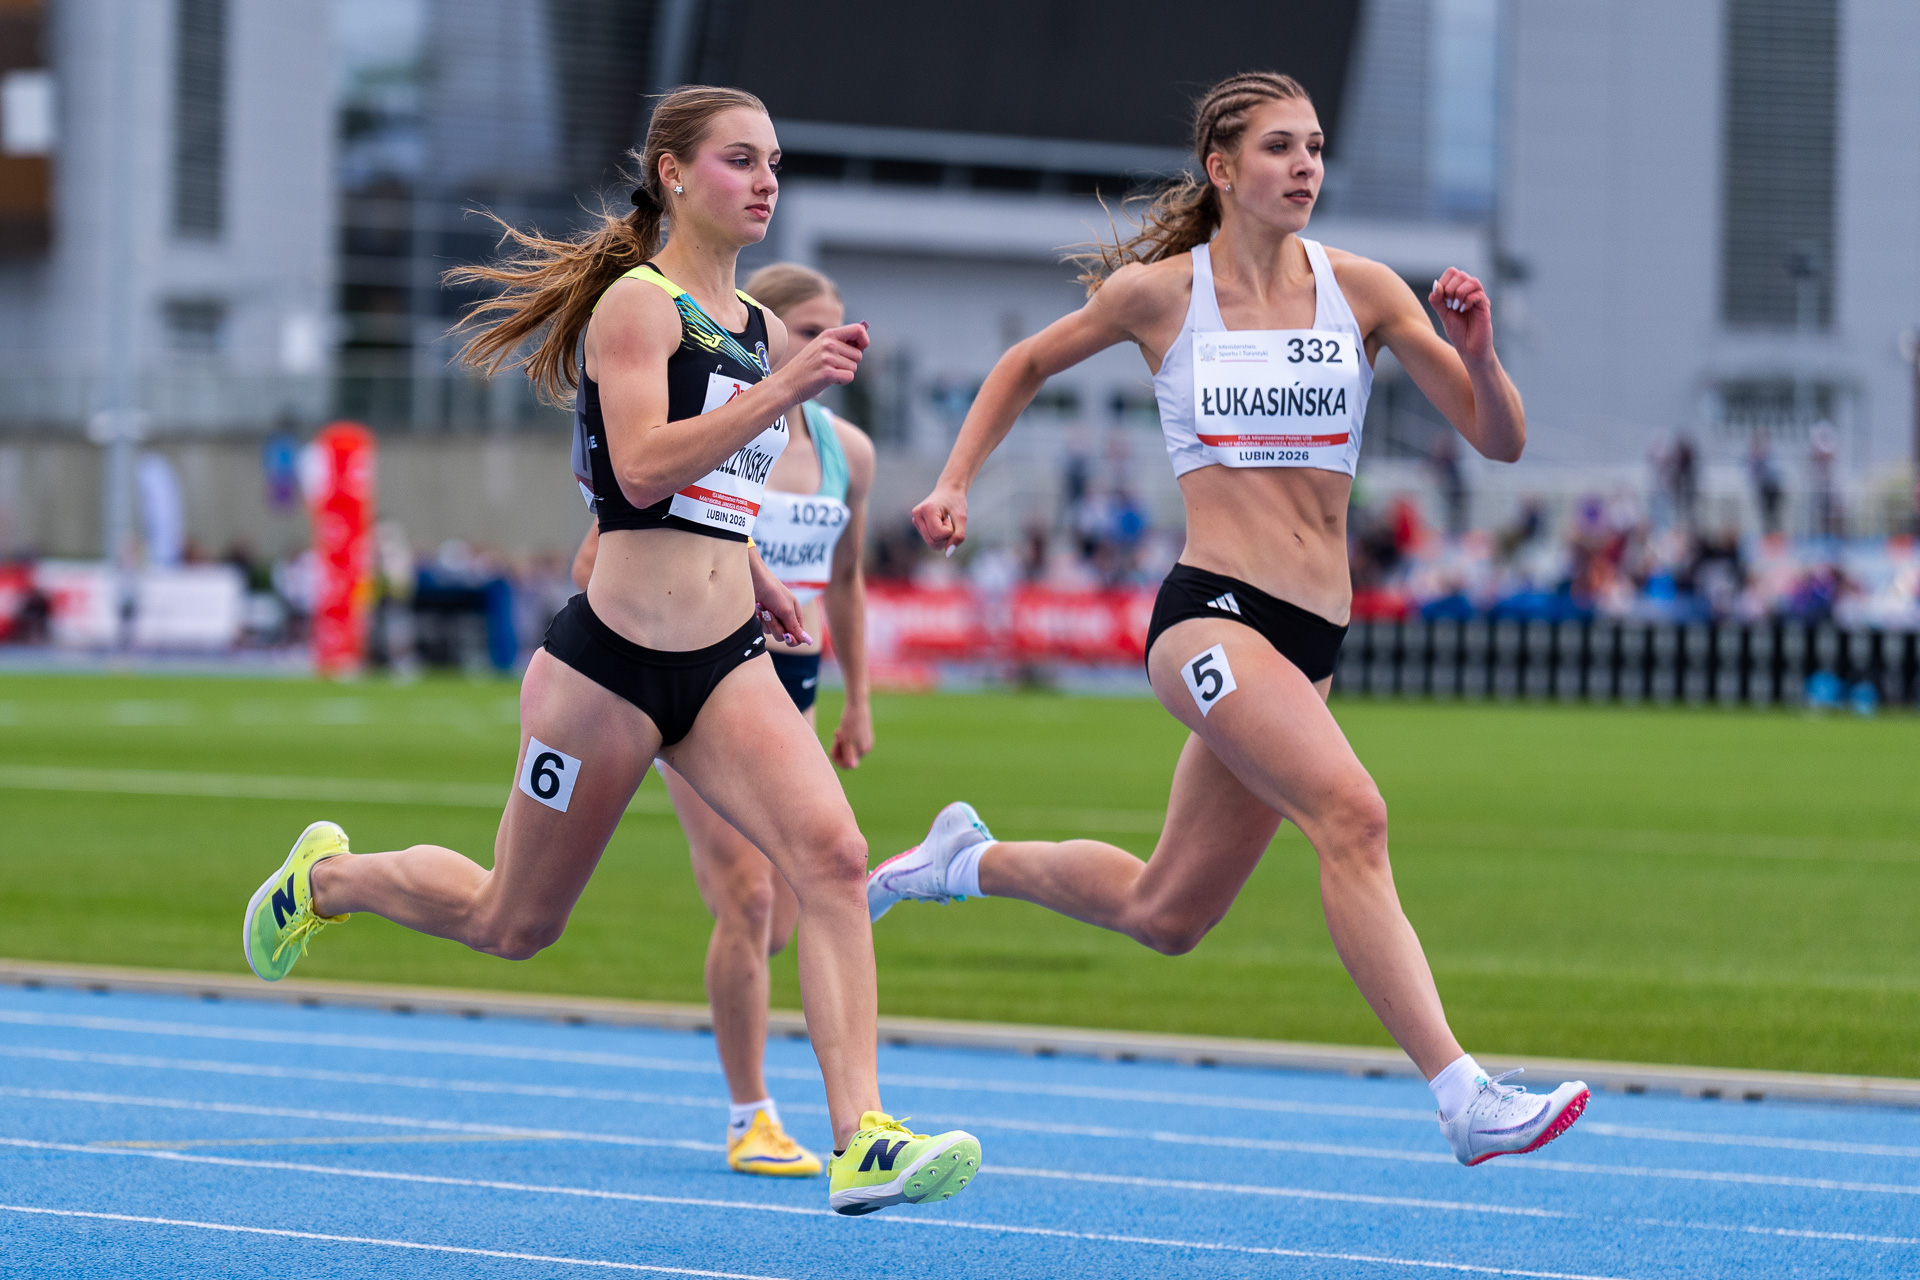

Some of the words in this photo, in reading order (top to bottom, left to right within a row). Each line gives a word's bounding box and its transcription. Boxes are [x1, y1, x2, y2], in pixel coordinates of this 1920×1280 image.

[1287, 338, 1343, 364] 332
[1201, 381, 1348, 417] ŁUKASIŃSKA
[1239, 451, 1275, 461] LUBIN
[1277, 450, 1310, 461] 2026
[706, 508, 729, 524] LUBIN
[729, 513, 746, 528] 2026
[790, 503, 844, 528] 1023
[755, 539, 826, 568] HALSKA
[1191, 652, 1224, 702] 5
[530, 751, 565, 800] 6
